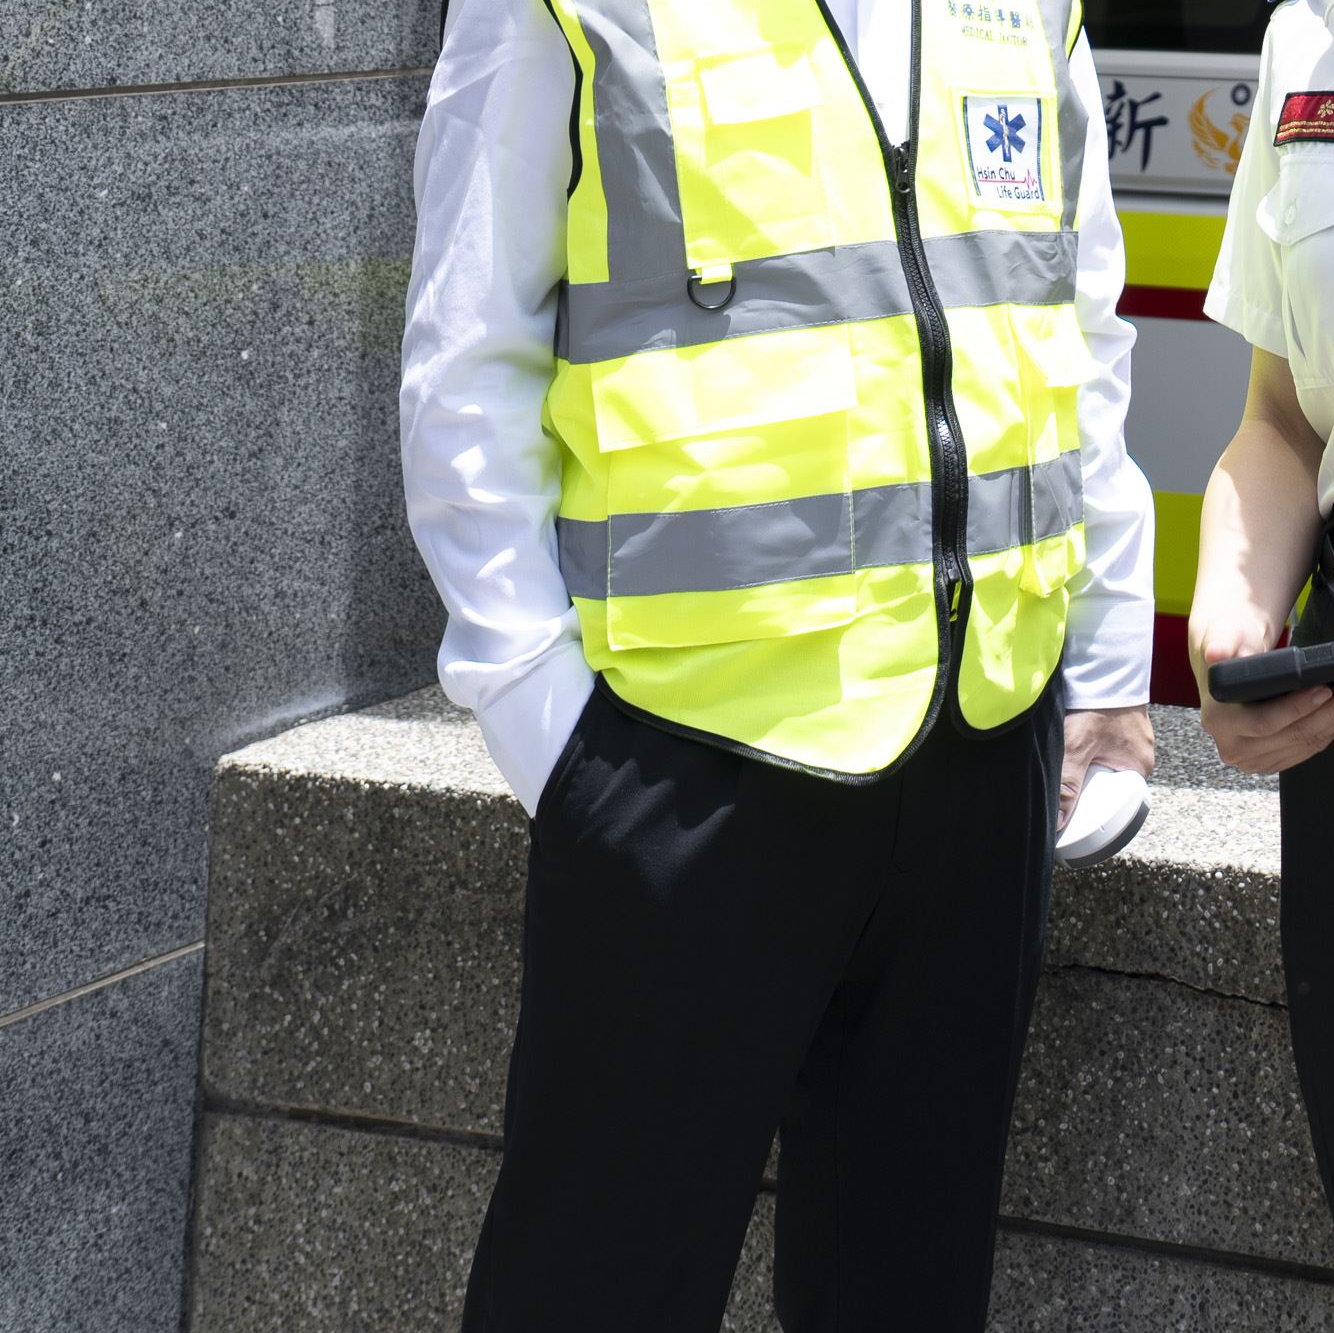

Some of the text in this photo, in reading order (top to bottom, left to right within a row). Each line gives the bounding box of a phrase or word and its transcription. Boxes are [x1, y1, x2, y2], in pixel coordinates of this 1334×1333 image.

[977, 167, 1016, 181] Hsin Chu
[996, 185, 1041, 200] Life Guard
